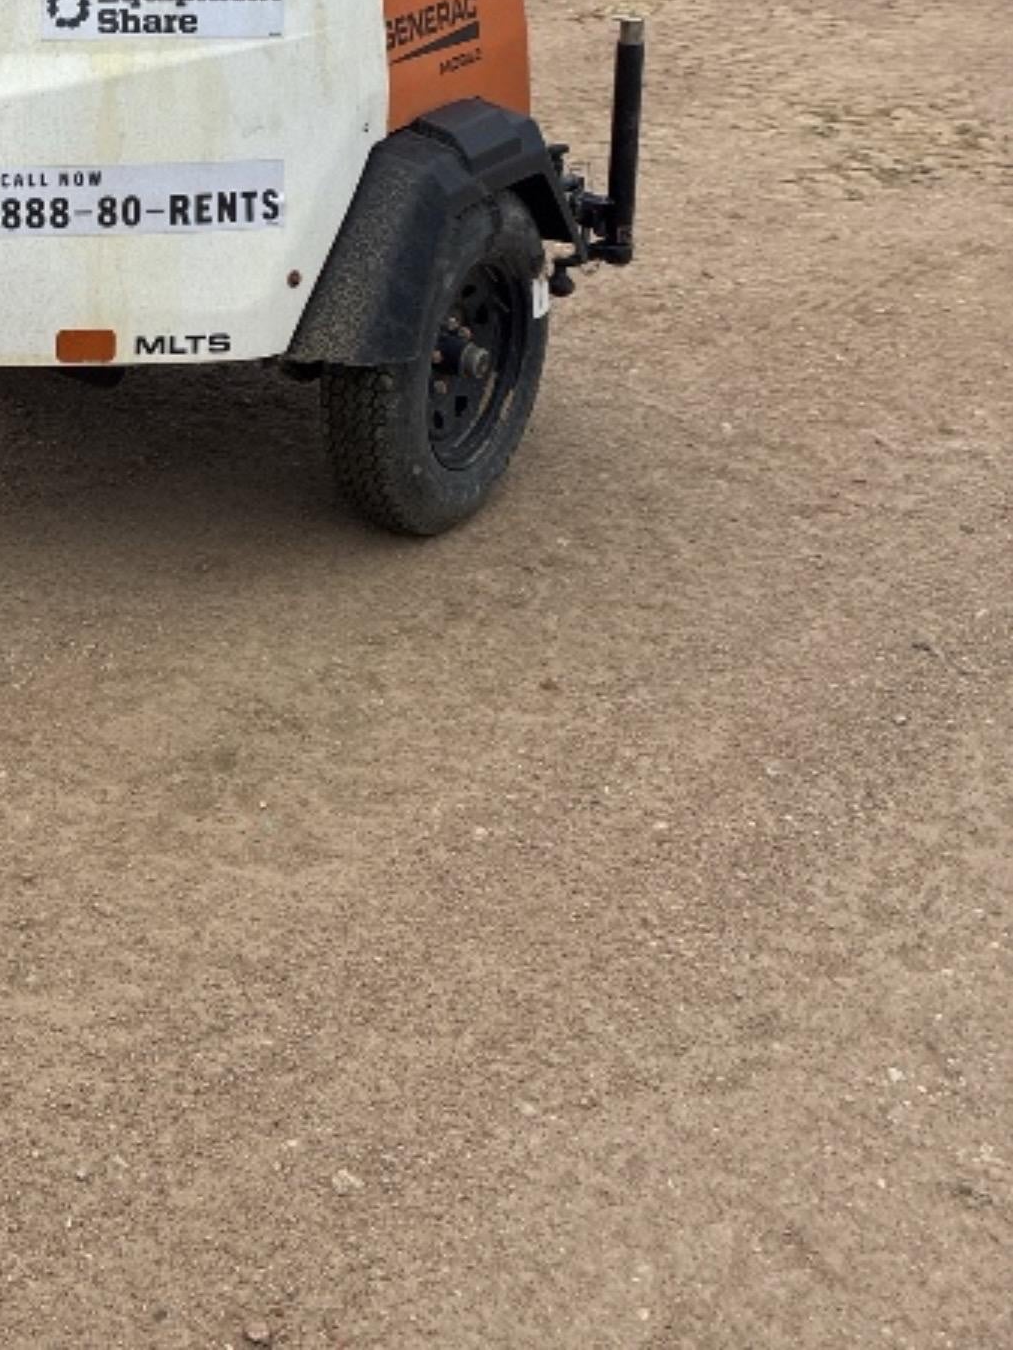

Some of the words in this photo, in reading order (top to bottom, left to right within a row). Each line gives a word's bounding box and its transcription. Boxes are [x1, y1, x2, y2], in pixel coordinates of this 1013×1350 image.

[97, 8, 198, 34] Share
[0, 173, 48, 188] CALL
[59, 171, 102, 187] NOW
[1, 188, 280, 229] 888-80-RENTS
[135, 333, 231, 354] MLTS
